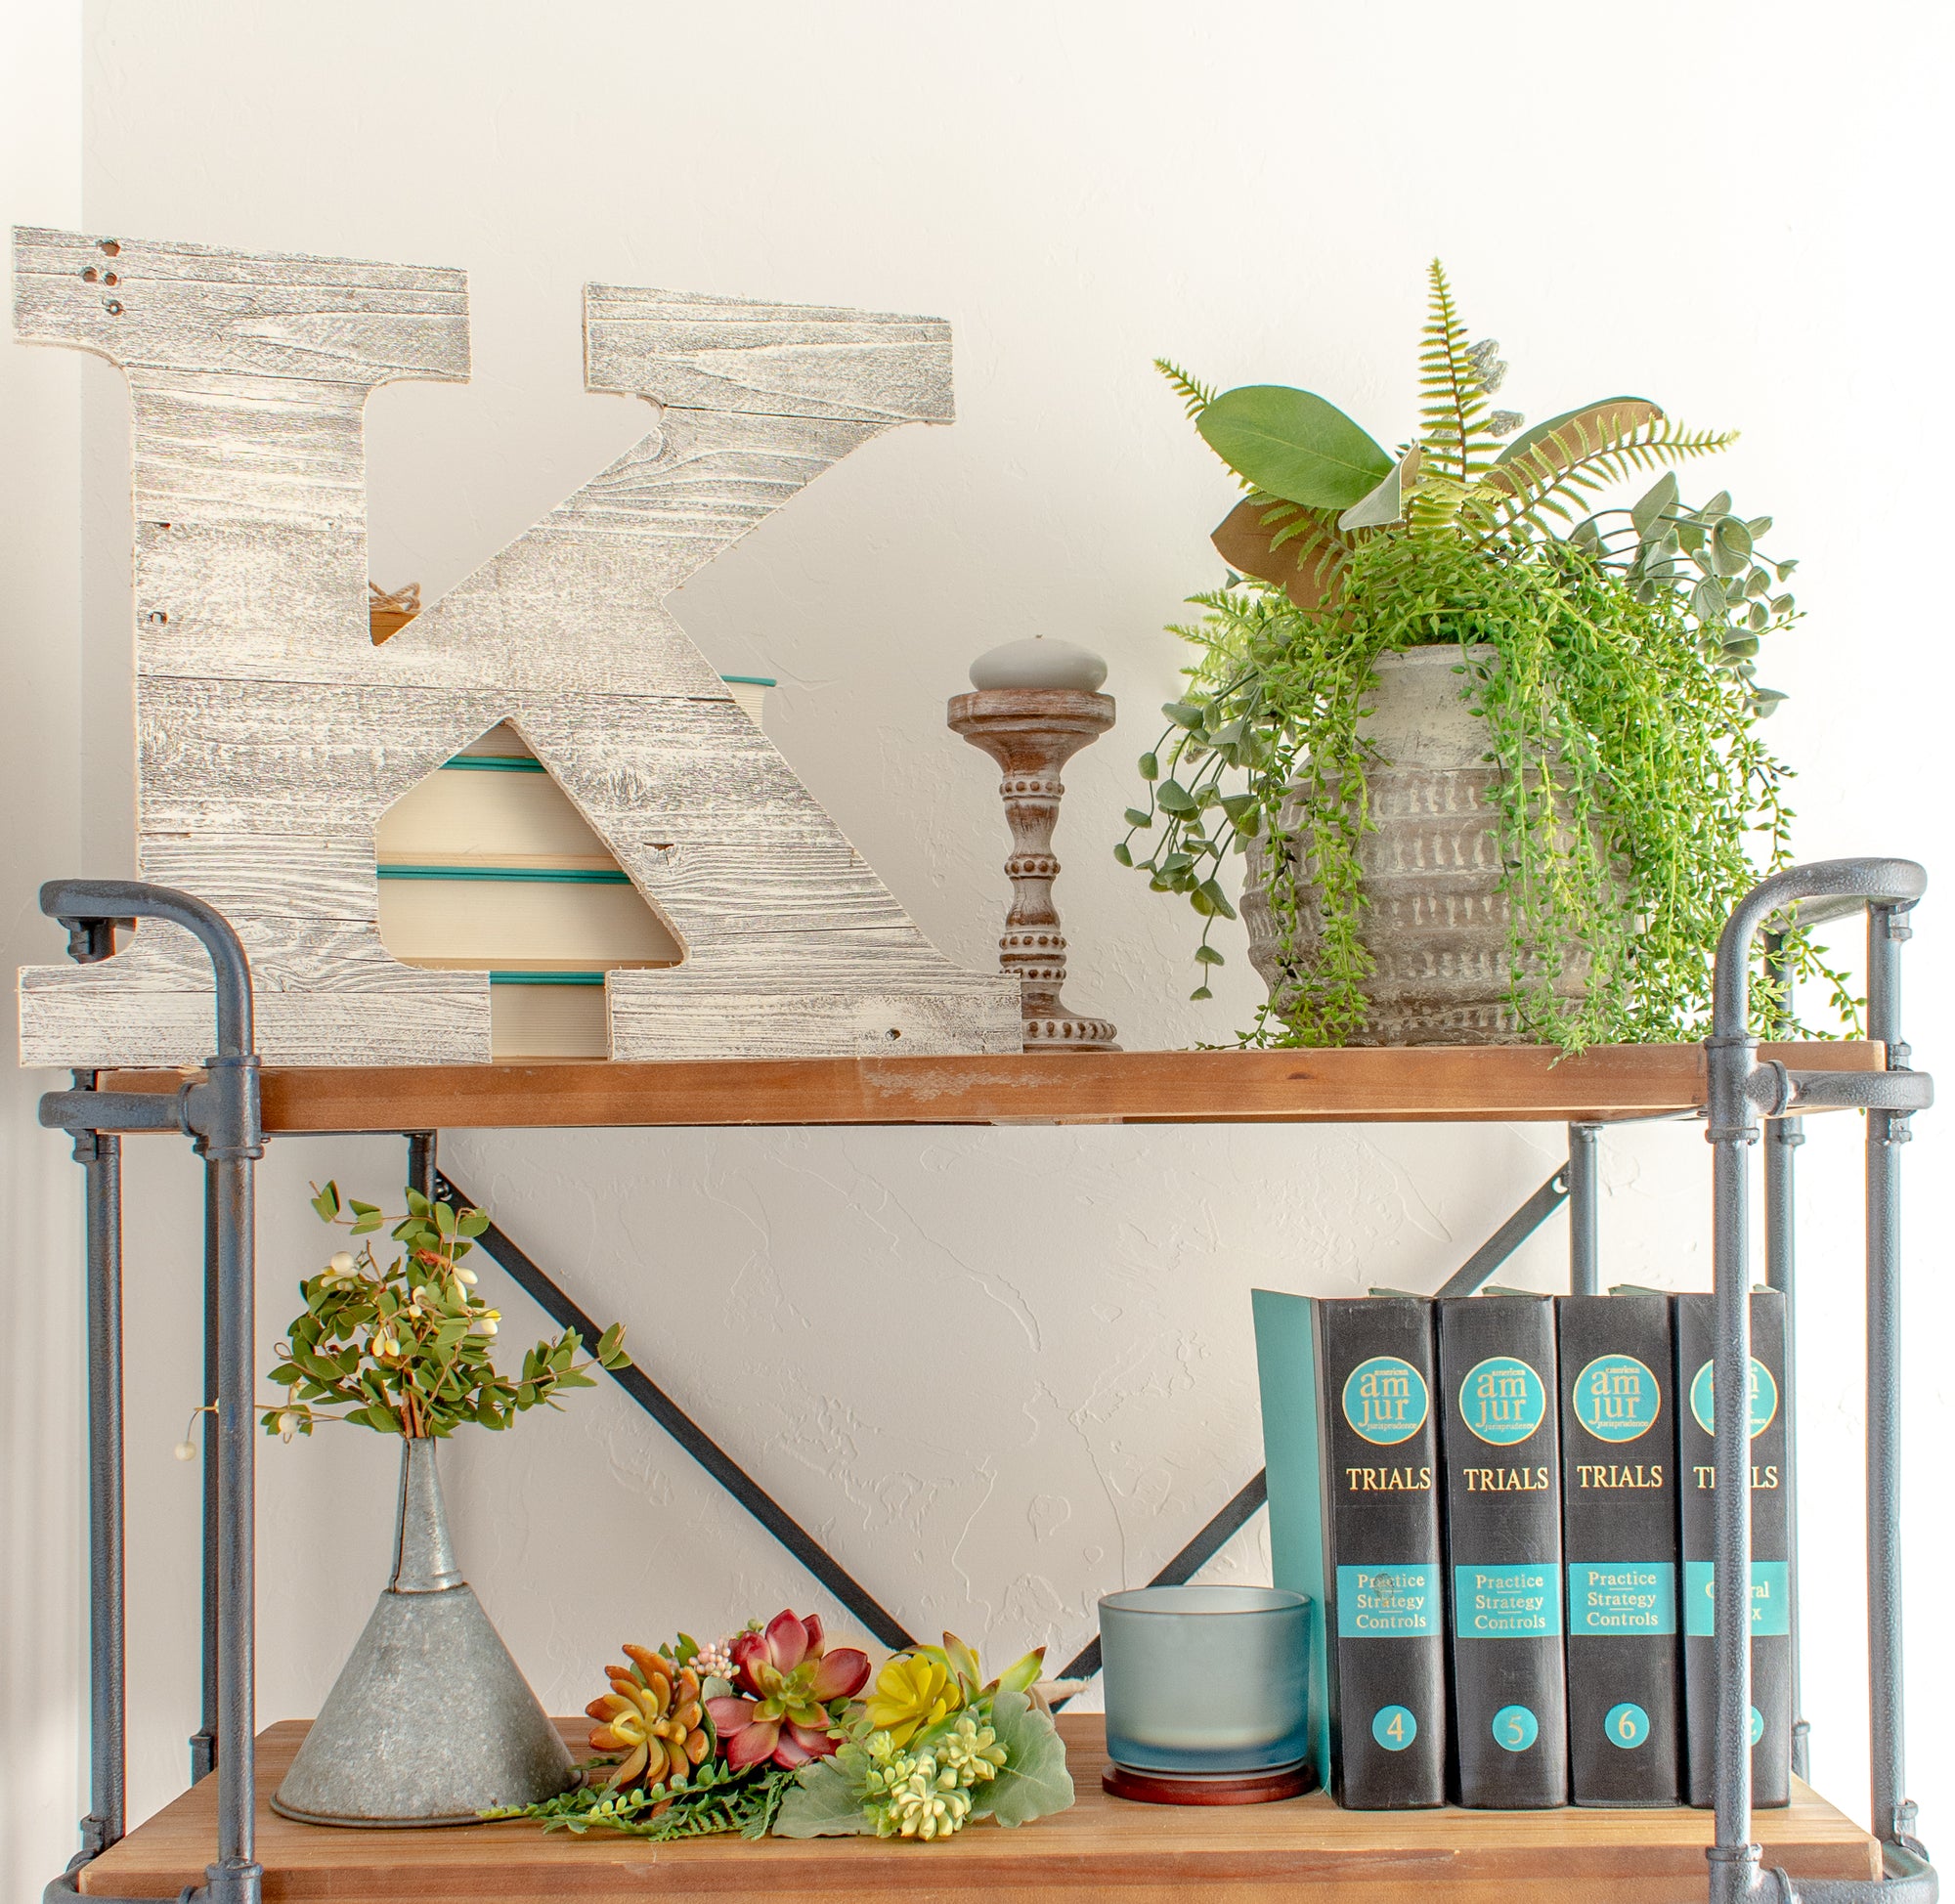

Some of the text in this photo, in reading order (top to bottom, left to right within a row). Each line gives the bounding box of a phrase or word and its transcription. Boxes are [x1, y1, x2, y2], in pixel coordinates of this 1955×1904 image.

[12, 226, 1022, 1068] K
[1360, 1373, 1411, 1398] am
[1477, 1373, 1528, 1398] am
[1590, 1370, 1641, 1395] am
[1358, 1397, 1410, 1427] jur
[1475, 1397, 1527, 1427] jur
[1588, 1395, 1641, 1423] jur
[1346, 1467, 1432, 1492] TRIALS
[1463, 1467, 1549, 1492] TRIALS
[1577, 1465, 1664, 1489] TRIALS
[1358, 1574, 1425, 1588] Practice
[1476, 1575, 1543, 1588] Practice
[1587, 1572, 1656, 1585] Practice
[1357, 1594, 1425, 1609] Strategy
[1475, 1595, 1542, 1610] Strategy
[1587, 1591, 1656, 1608] Strategy
[1356, 1615, 1426, 1627] Controls
[1475, 1615, 1545, 1629] Controls
[1586, 1613, 1658, 1625] Controls
[1387, 1713, 1404, 1742] 4
[1507, 1715, 1524, 1744] 5
[1619, 1710, 1635, 1740] 6
